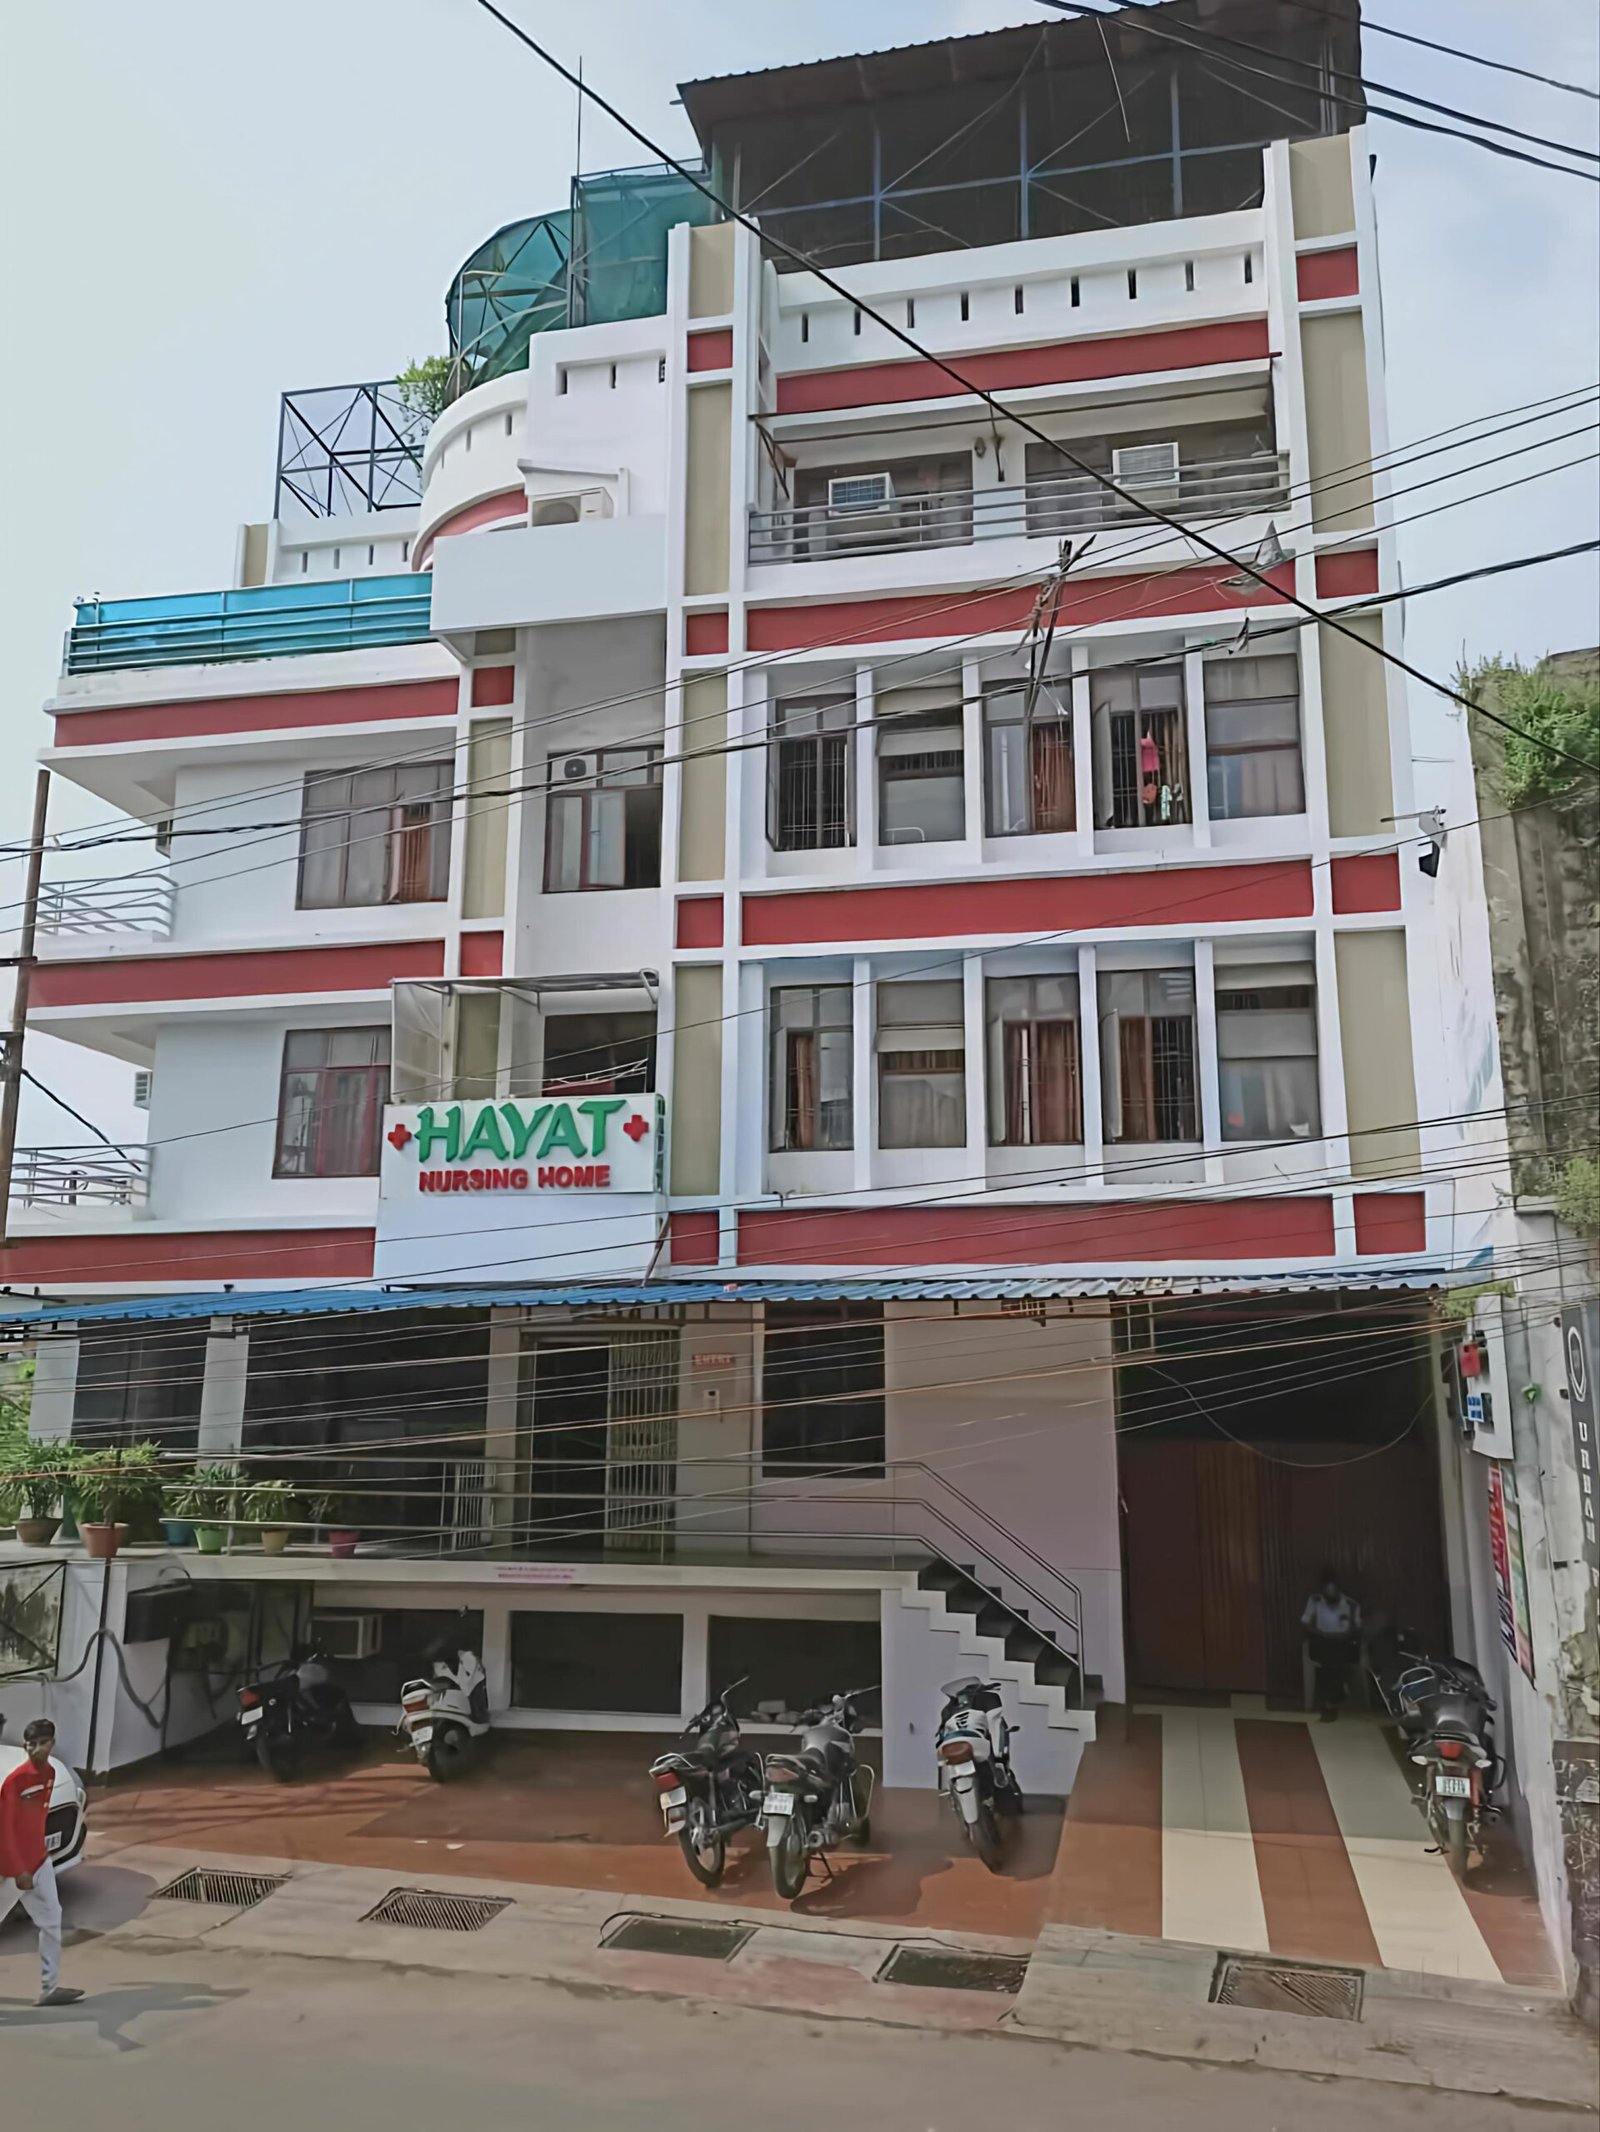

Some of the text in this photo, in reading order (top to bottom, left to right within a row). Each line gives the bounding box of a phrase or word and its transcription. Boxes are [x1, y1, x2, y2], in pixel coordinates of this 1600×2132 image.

[414, 1099, 627, 1163] HAYAT
[419, 1165, 611, 1193] NURSING HOME
